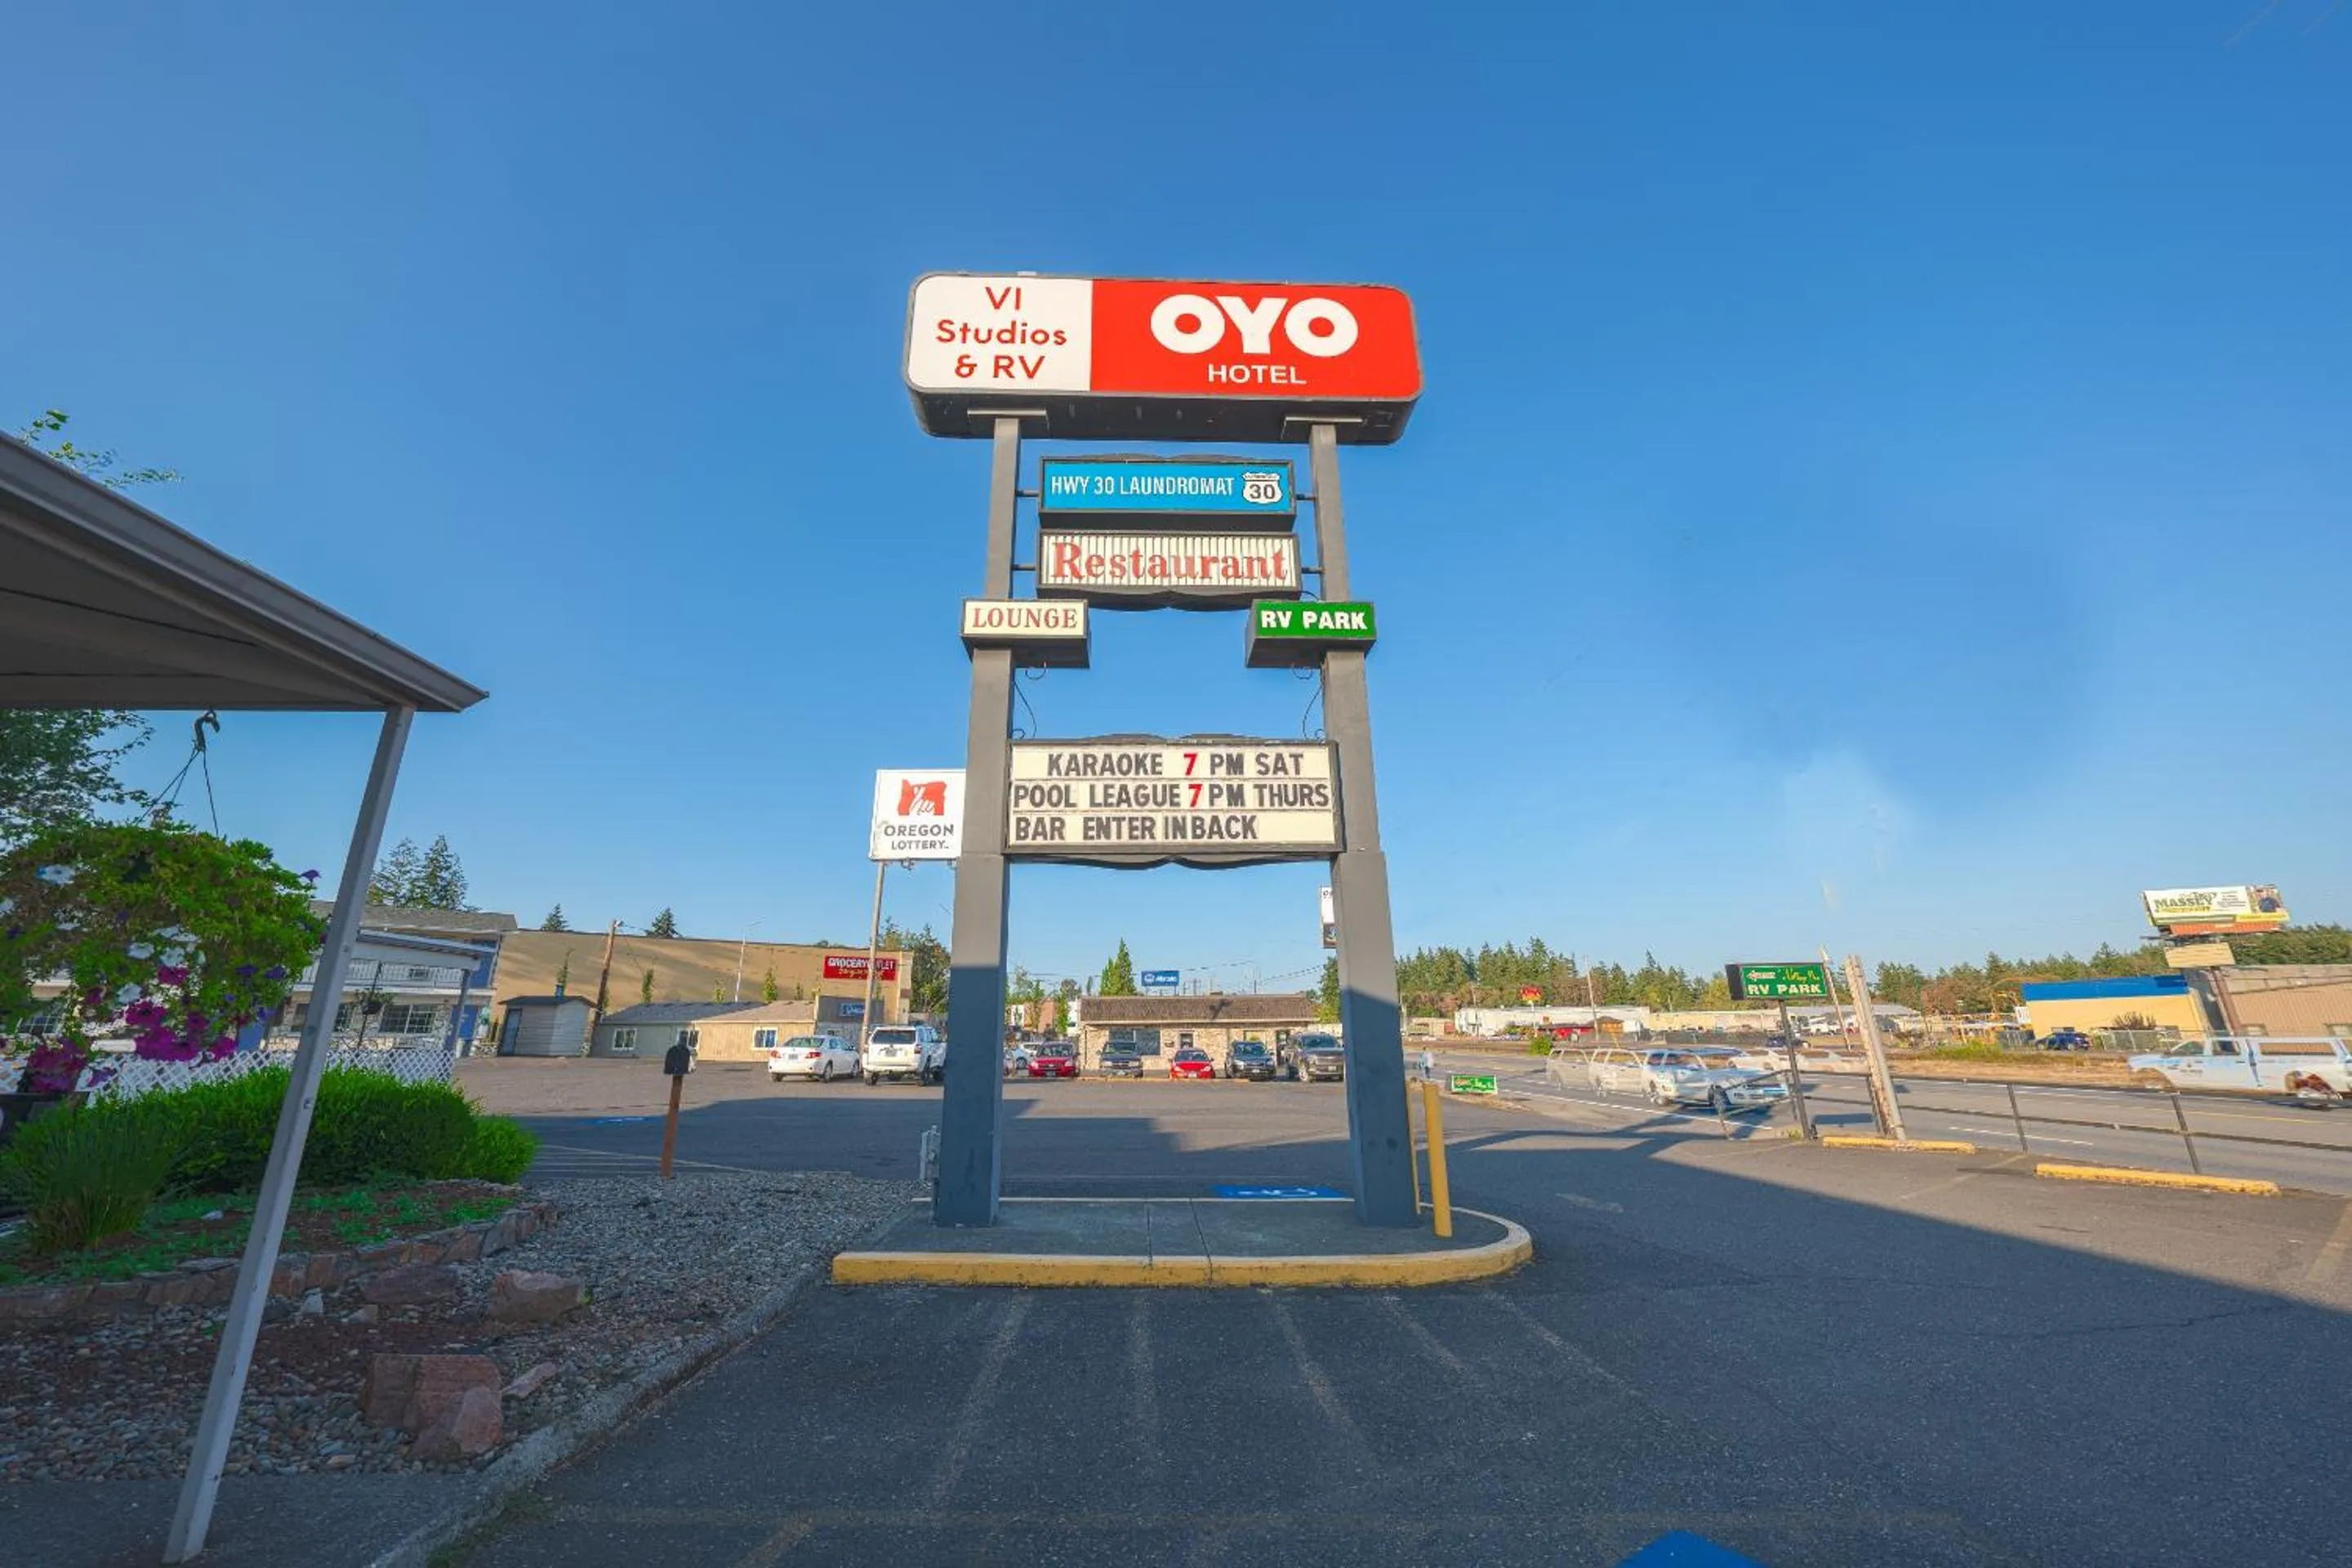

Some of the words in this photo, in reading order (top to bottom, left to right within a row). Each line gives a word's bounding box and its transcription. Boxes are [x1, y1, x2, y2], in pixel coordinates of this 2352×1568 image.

[985, 287, 1021, 310] VI
[936, 319, 1067, 346] Studios
[1150, 294, 1358, 356] OYO
[955, 355, 977, 377] &
[992, 355, 1045, 379] RV
[1208, 363, 1306, 385] HOTEL
[1051, 476, 1089, 494] HWY
[1094, 476, 1114, 495] 30
[1120, 476, 1234, 497] LAUNDROMAT
[1249, 483, 1276, 500] 30
[1050, 541, 1288, 581] Restaurant
[972, 608, 1078, 629] LOUNGE
[1260, 610, 1290, 628] RV
[1303, 611, 1368, 630] PARK
[1047, 753, 1163, 776] KARAOKE
[1183, 753, 1198, 776] 7
[1209, 753, 1245, 776] PM
[1255, 753, 1304, 776] SAT
[1013, 785, 1076, 808] POOL
[1089, 784, 1180, 808] LEAGUE
[1188, 784, 1202, 808] 7
[1209, 784, 1245, 808] PM
[1254, 784, 1330, 808] THURS
[884, 823, 954, 837] OREGON
[1015, 817, 1065, 840] BAR
[1082, 816, 1156, 840] ENTER
[1748, 984, 1769, 995] RV
[1777, 984, 1822, 994] PARK
